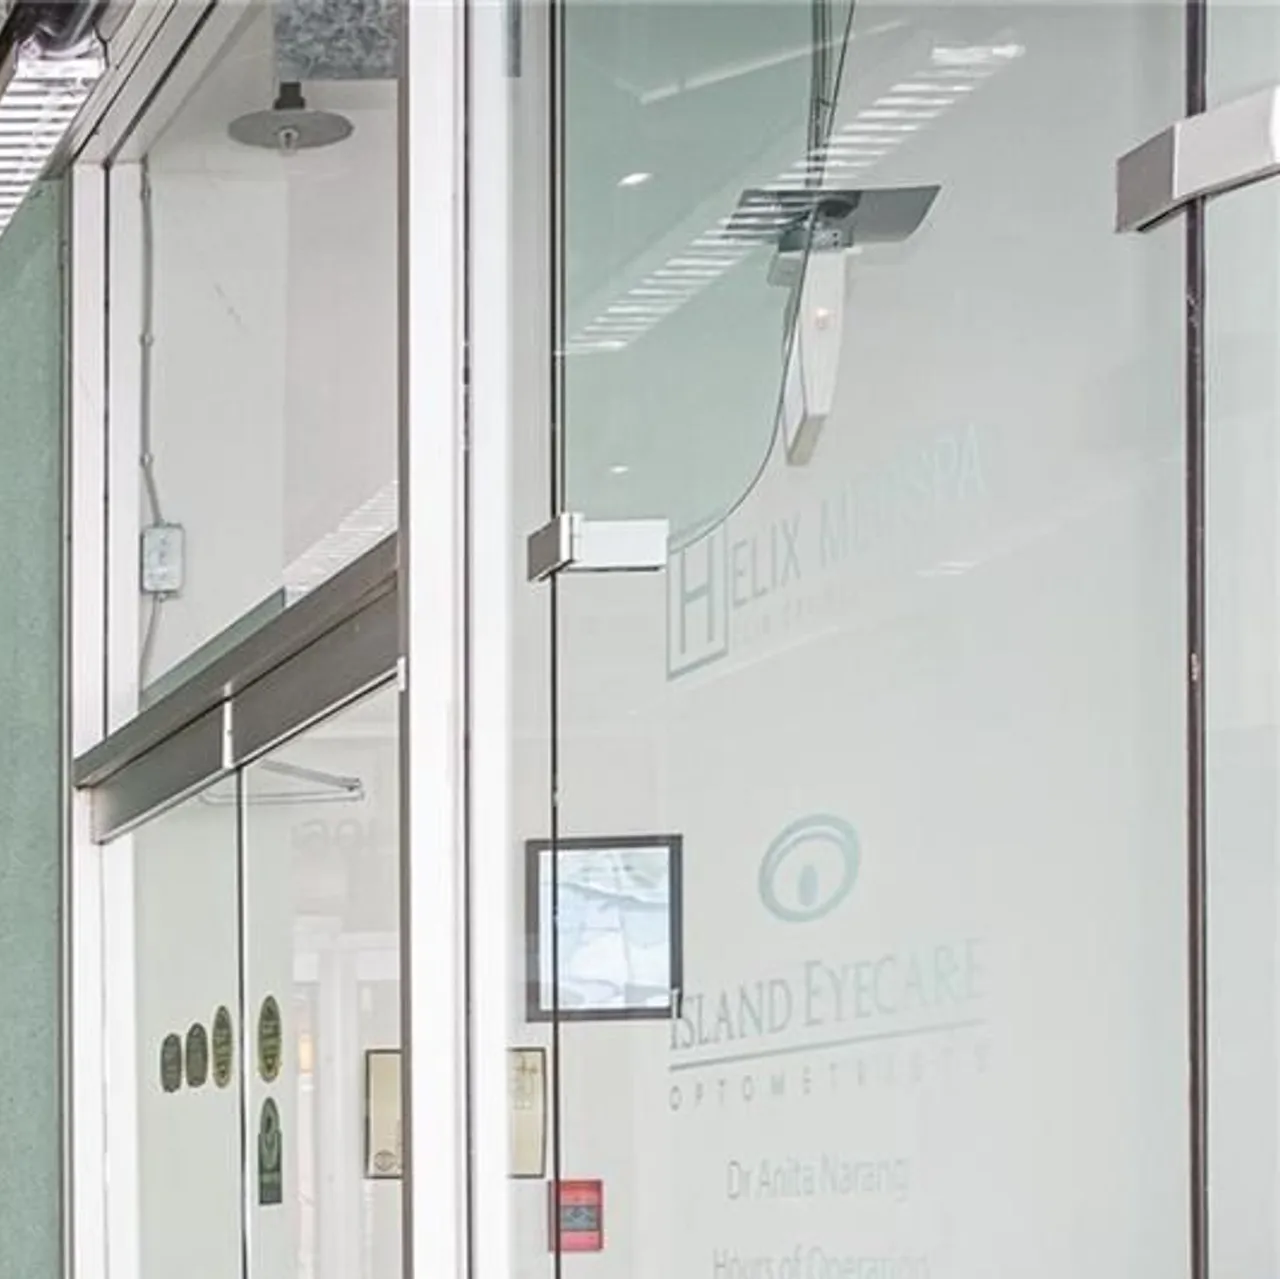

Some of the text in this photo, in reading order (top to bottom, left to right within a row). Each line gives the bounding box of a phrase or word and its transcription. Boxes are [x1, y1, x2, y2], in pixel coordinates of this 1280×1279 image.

[669, 937, 989, 1052] ISLAND EYECARE
[726, 1158, 753, 1200] Dr
[759, 1155, 817, 1197] Anita
